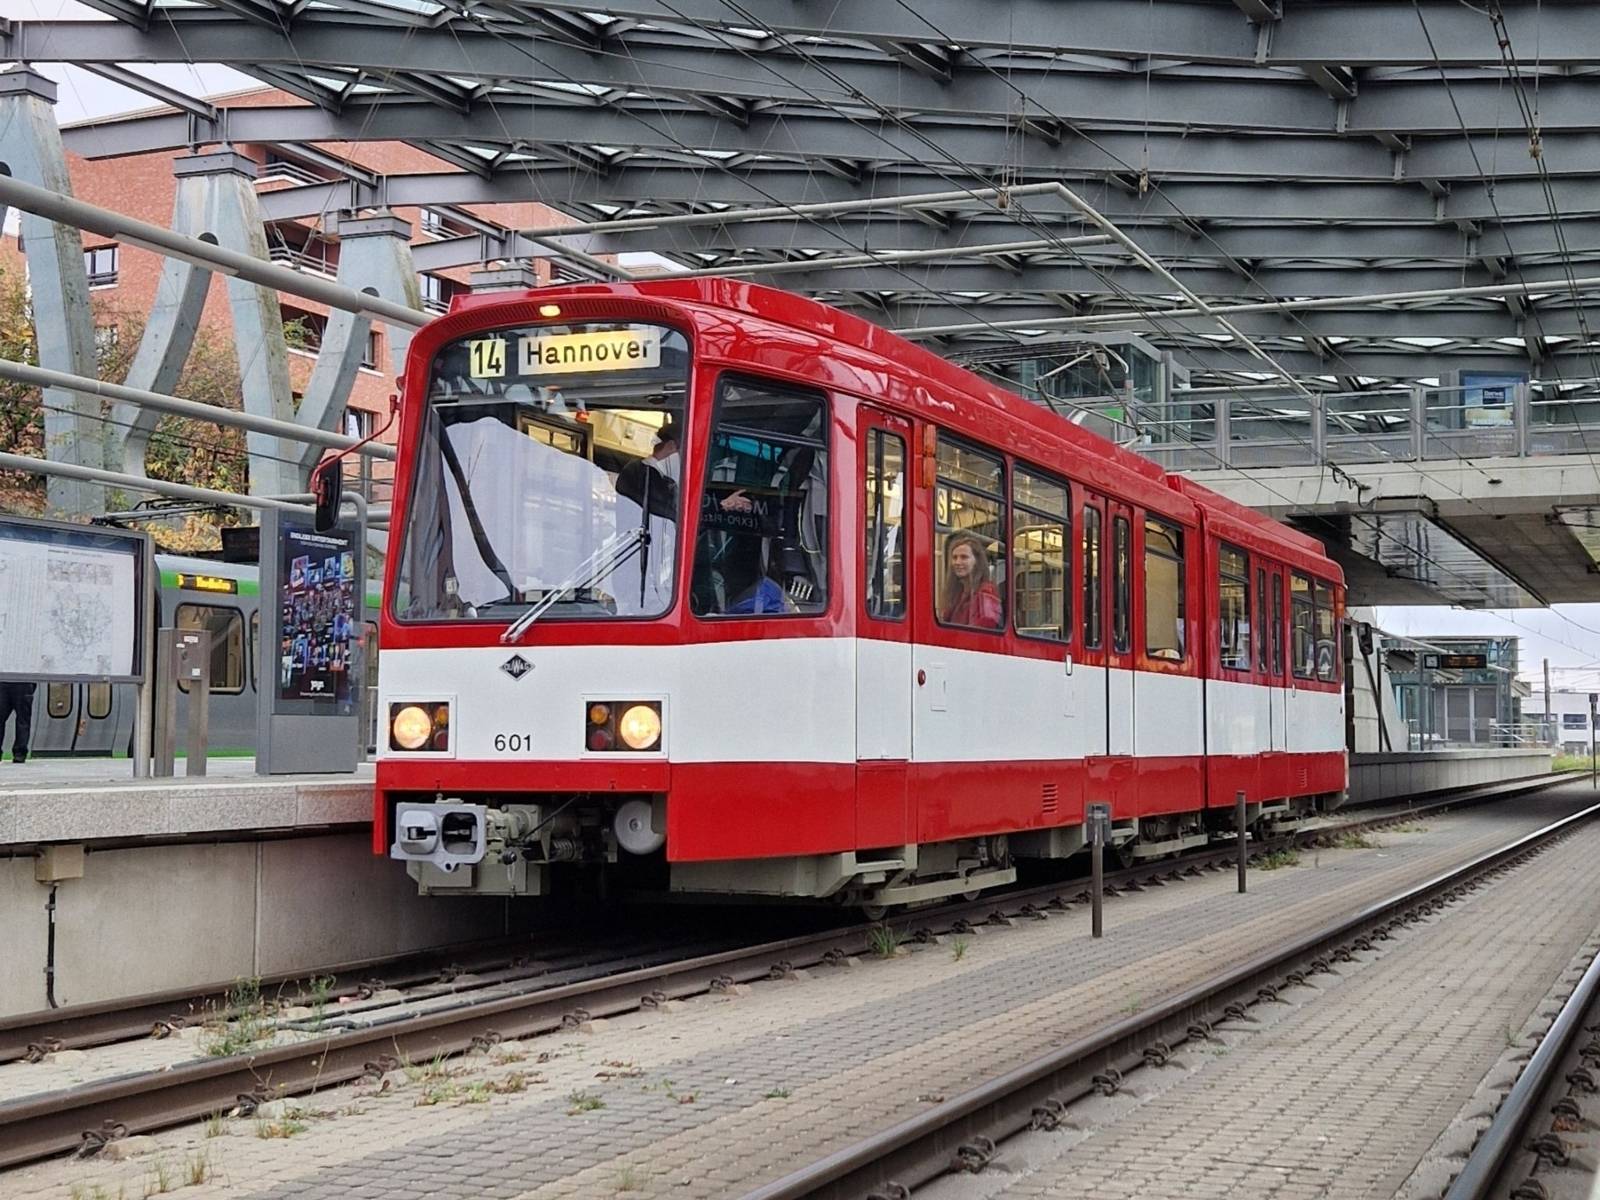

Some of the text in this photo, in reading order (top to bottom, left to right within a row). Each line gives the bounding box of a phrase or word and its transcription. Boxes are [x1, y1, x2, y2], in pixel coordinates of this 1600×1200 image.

[475, 340, 653, 374] 14 Hannover
[494, 734, 531, 751] 601
